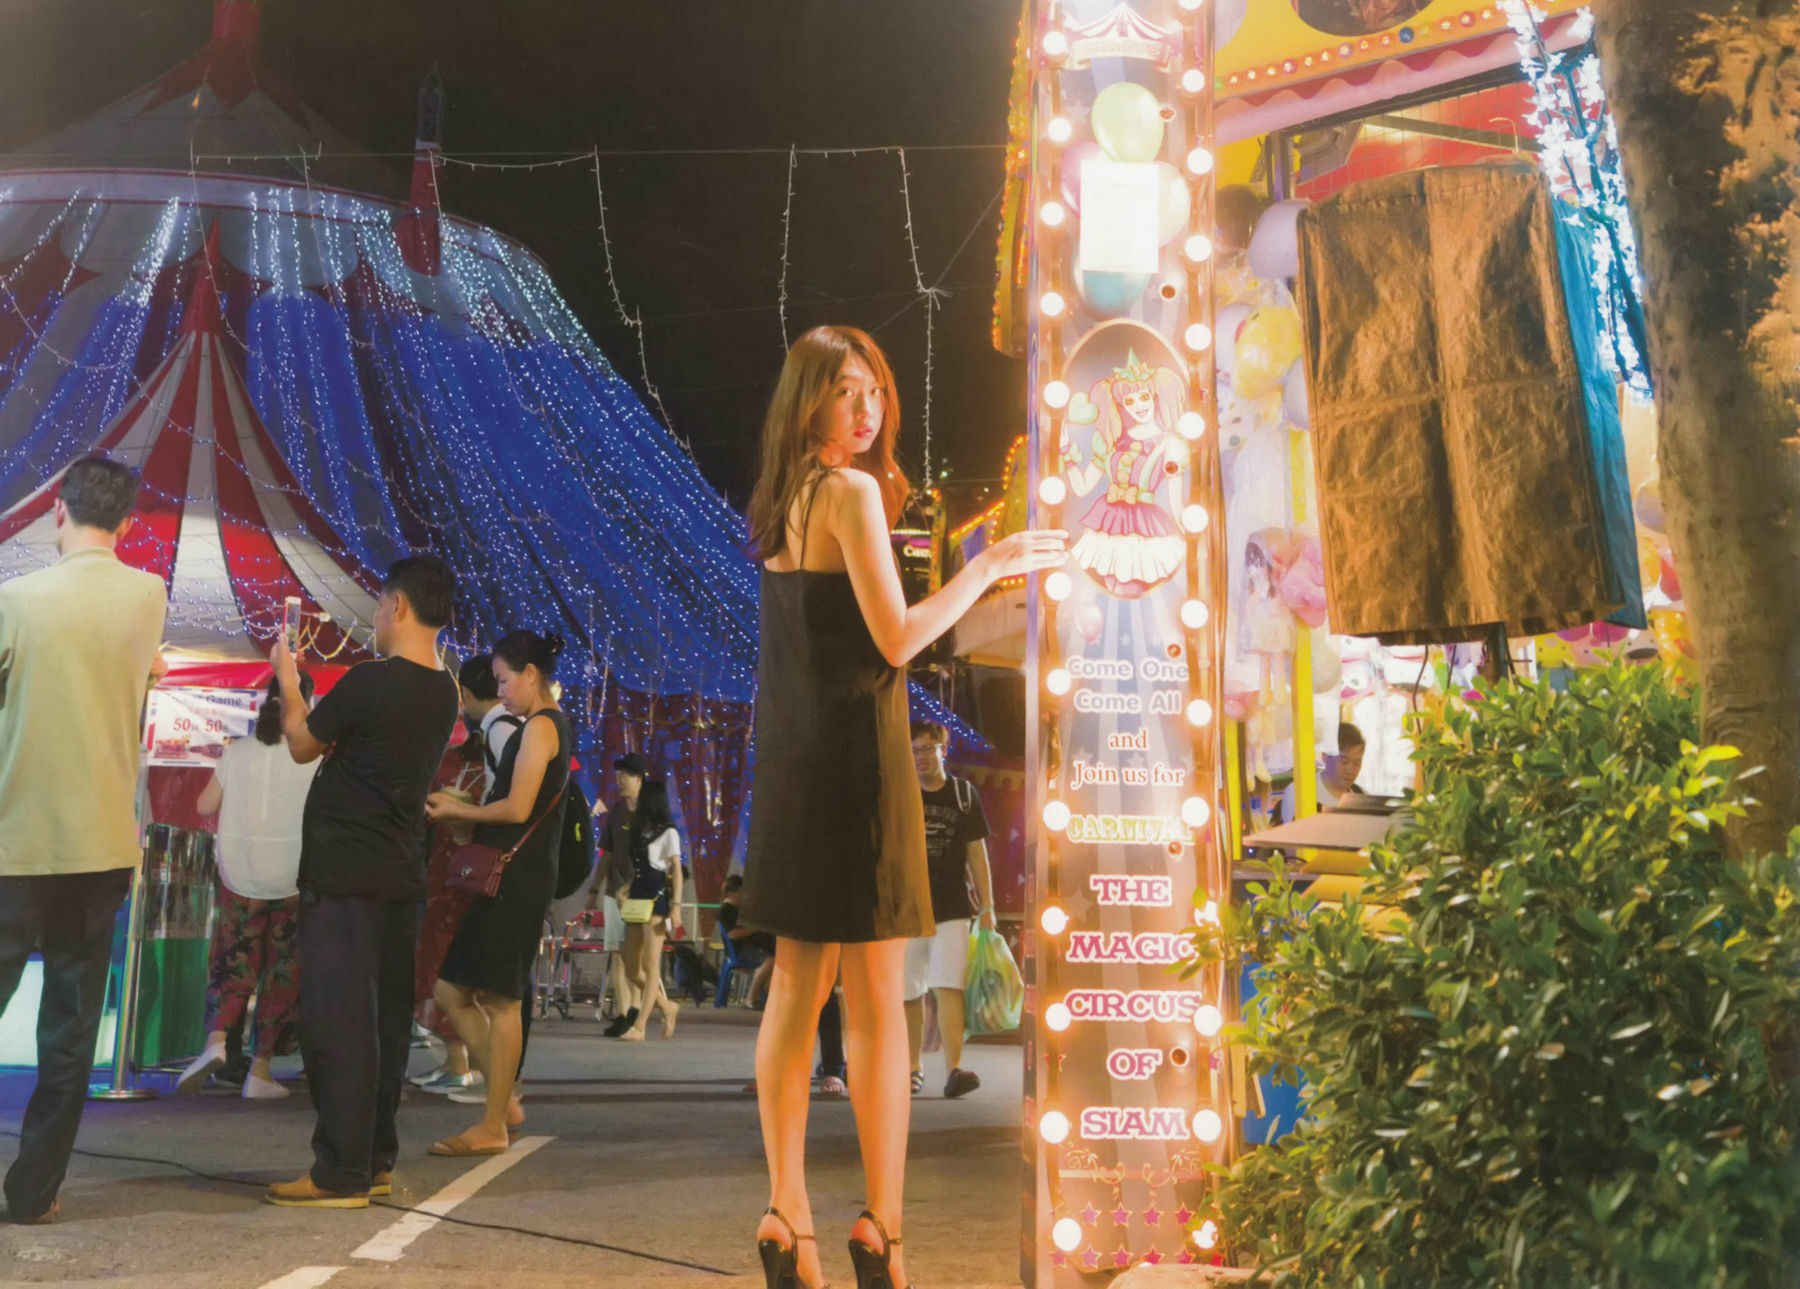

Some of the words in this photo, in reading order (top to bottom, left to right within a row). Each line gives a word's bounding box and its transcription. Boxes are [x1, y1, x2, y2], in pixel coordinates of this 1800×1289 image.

[1067, 655, 1131, 678] Come
[1142, 659, 1189, 679] One
[1075, 690, 1140, 710] Come
[1151, 691, 1181, 713] All
[173, 718, 191, 731] 50
[204, 718, 223, 732] 50
[1109, 728, 1148, 749] and
[1072, 762, 1118, 788] Join
[1123, 768, 1148, 784] us
[1153, 763, 1184, 785] for
[1092, 877, 1170, 905] THE
[1068, 933, 1197, 961] MAGIC
[1065, 992, 1200, 1019] CIRCUS
[1108, 1050, 1160, 1077] OF
[1082, 1109, 1187, 1137] SIAM
